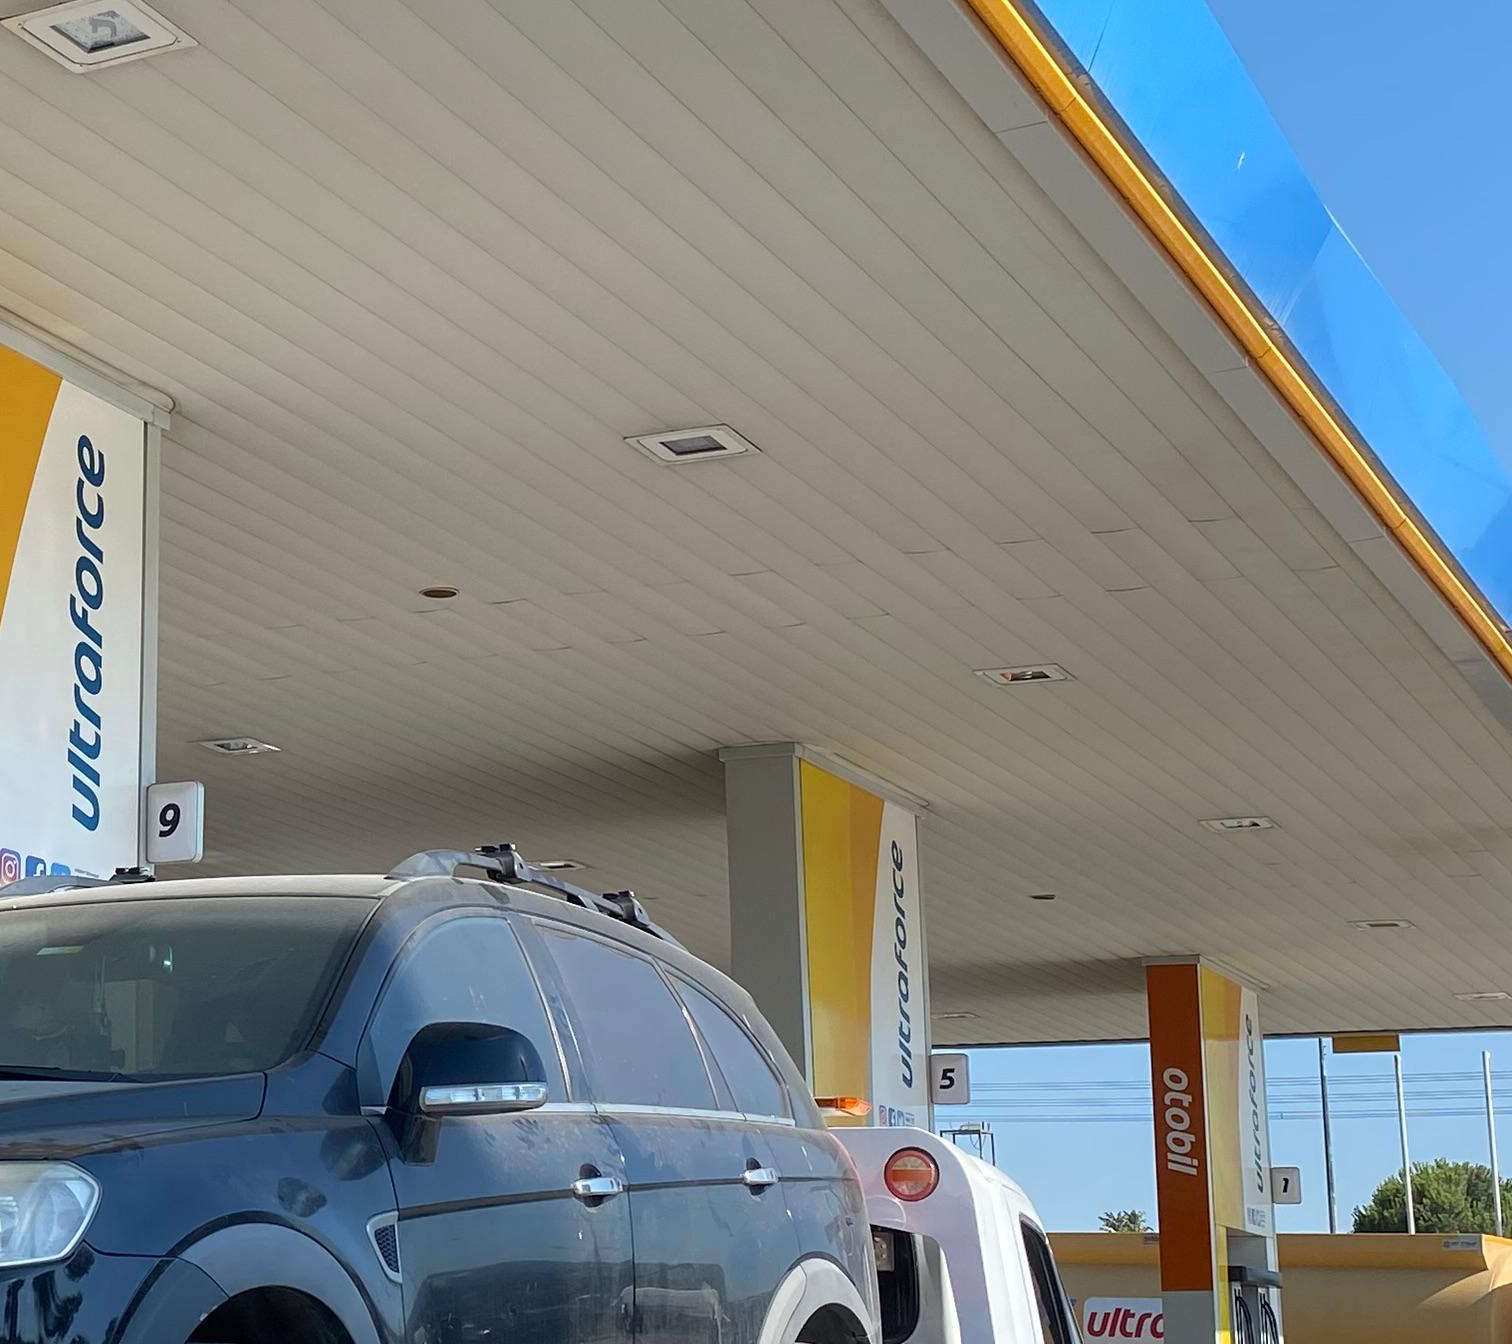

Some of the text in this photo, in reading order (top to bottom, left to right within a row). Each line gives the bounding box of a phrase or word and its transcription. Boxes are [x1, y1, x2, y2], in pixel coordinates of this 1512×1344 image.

[67, 433, 106, 833] ultraforce
[157, 802, 182, 838] 9
[891, 839, 913, 1090] ultraforce
[939, 1067, 956, 1090] 5
[1162, 1066, 1199, 1177] otobil
[1245, 1012, 1264, 1194] ultraforce
[1281, 1176, 1290, 1194] 1
